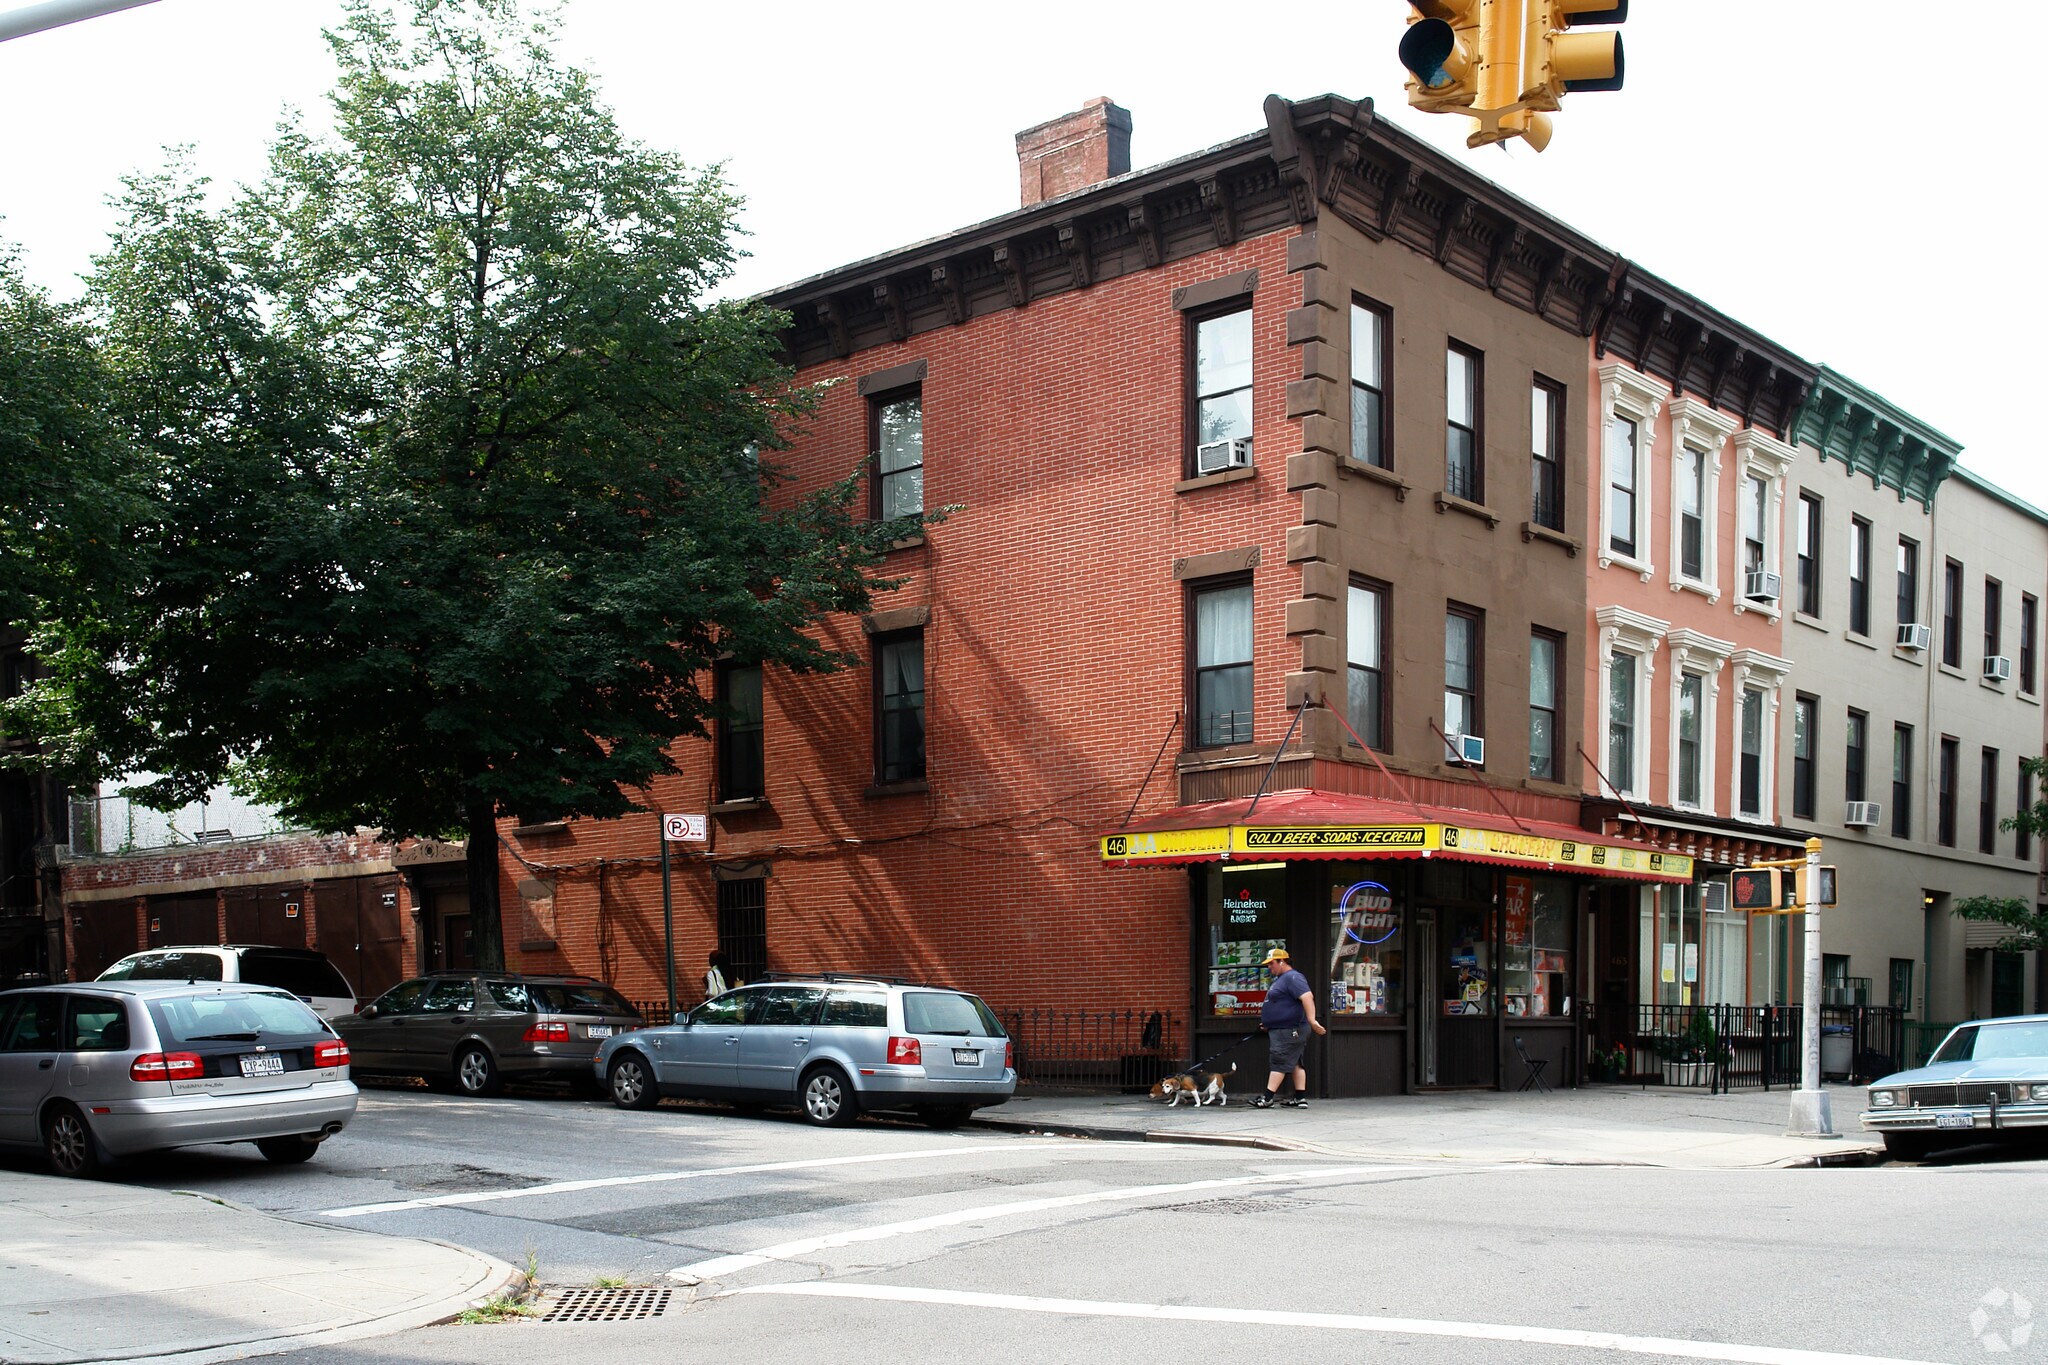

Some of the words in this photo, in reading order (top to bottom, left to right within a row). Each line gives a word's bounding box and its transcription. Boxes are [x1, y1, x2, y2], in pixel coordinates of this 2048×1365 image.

[1249, 833, 1282, 844] COLD
[1282, 832, 1317, 844] BEER
[1321, 832, 1359, 844] SODAS
[1362, 832, 1382, 843] ICE
[1382, 831, 1423, 843] CREAM
[1108, 839, 1127, 854] 461
[1223, 898, 1267, 909] Heineken
[1355, 895, 1392, 912] BUD
[1344, 911, 1398, 930] LIGHT
